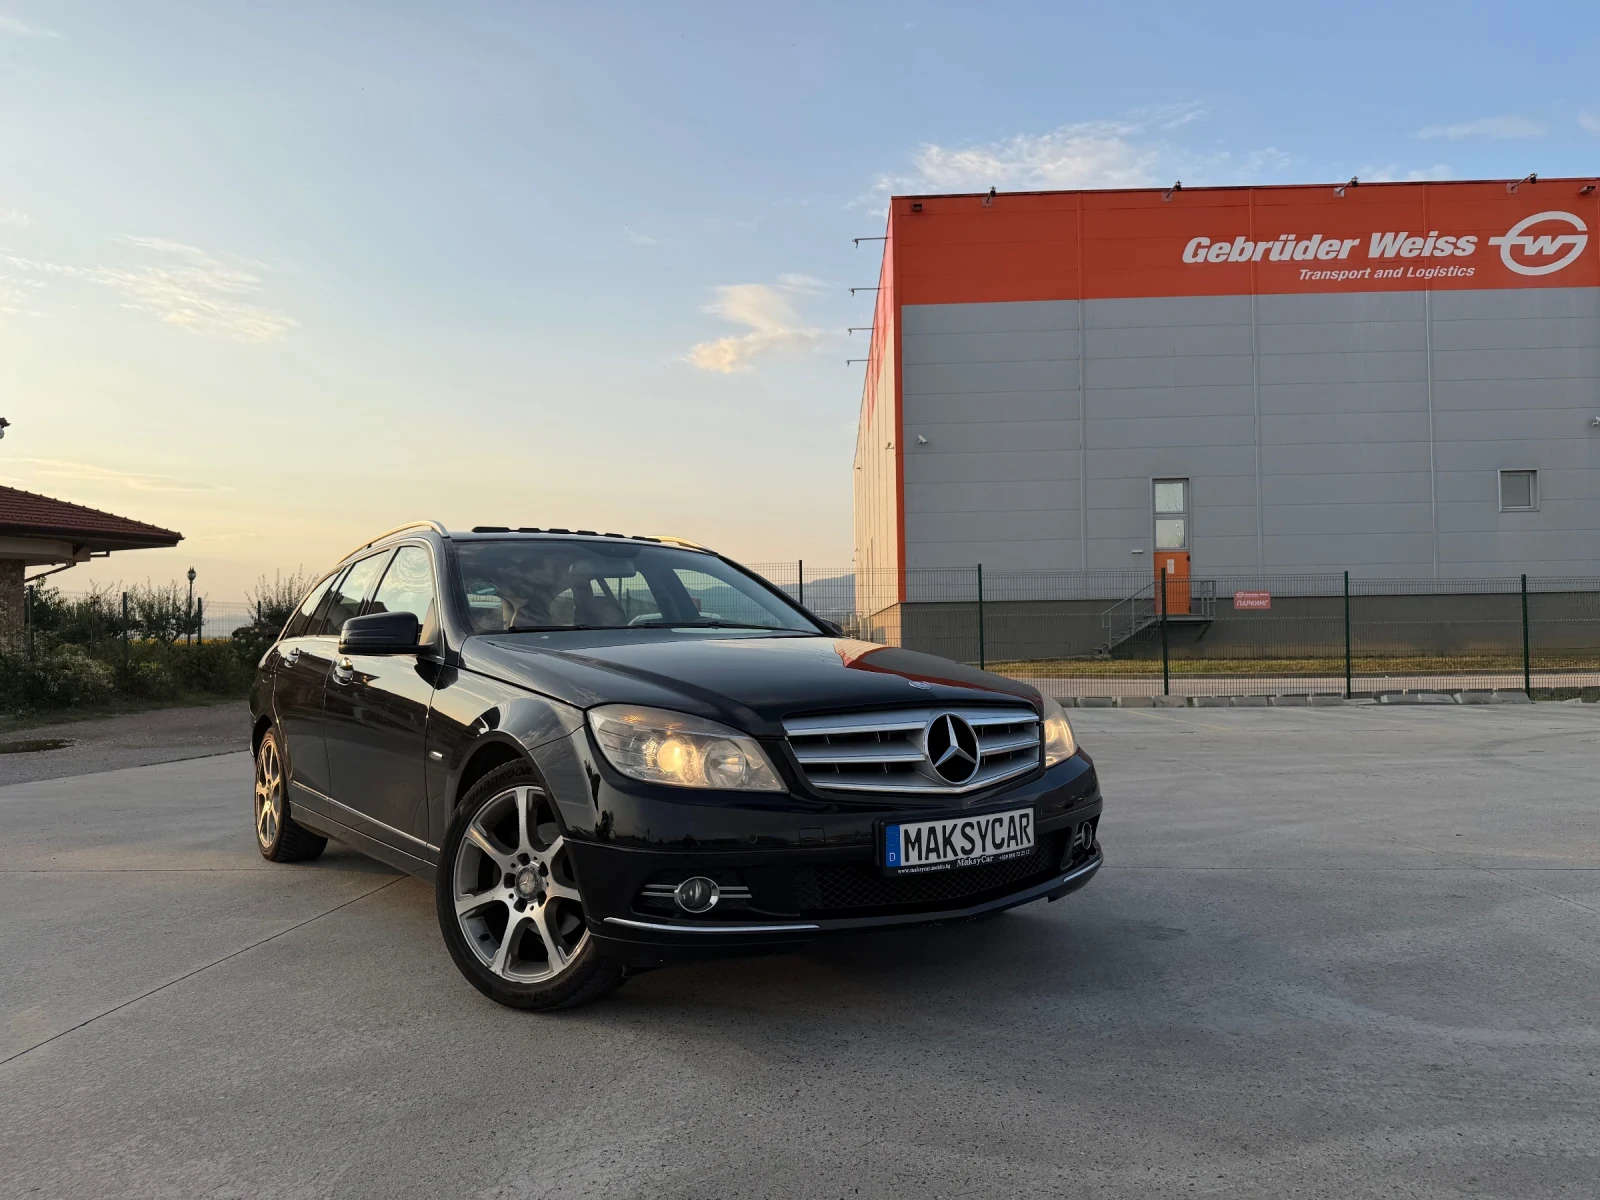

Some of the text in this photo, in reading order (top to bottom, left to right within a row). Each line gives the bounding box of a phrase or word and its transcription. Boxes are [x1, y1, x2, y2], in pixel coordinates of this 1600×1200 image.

[1182, 230, 1478, 264] Gebrüder Weiss
[1299, 264, 1475, 281] Transport and Logistics
[889, 813, 1031, 862] D MAKSYCAR
[956, 854, 994, 867] MaksyCar
